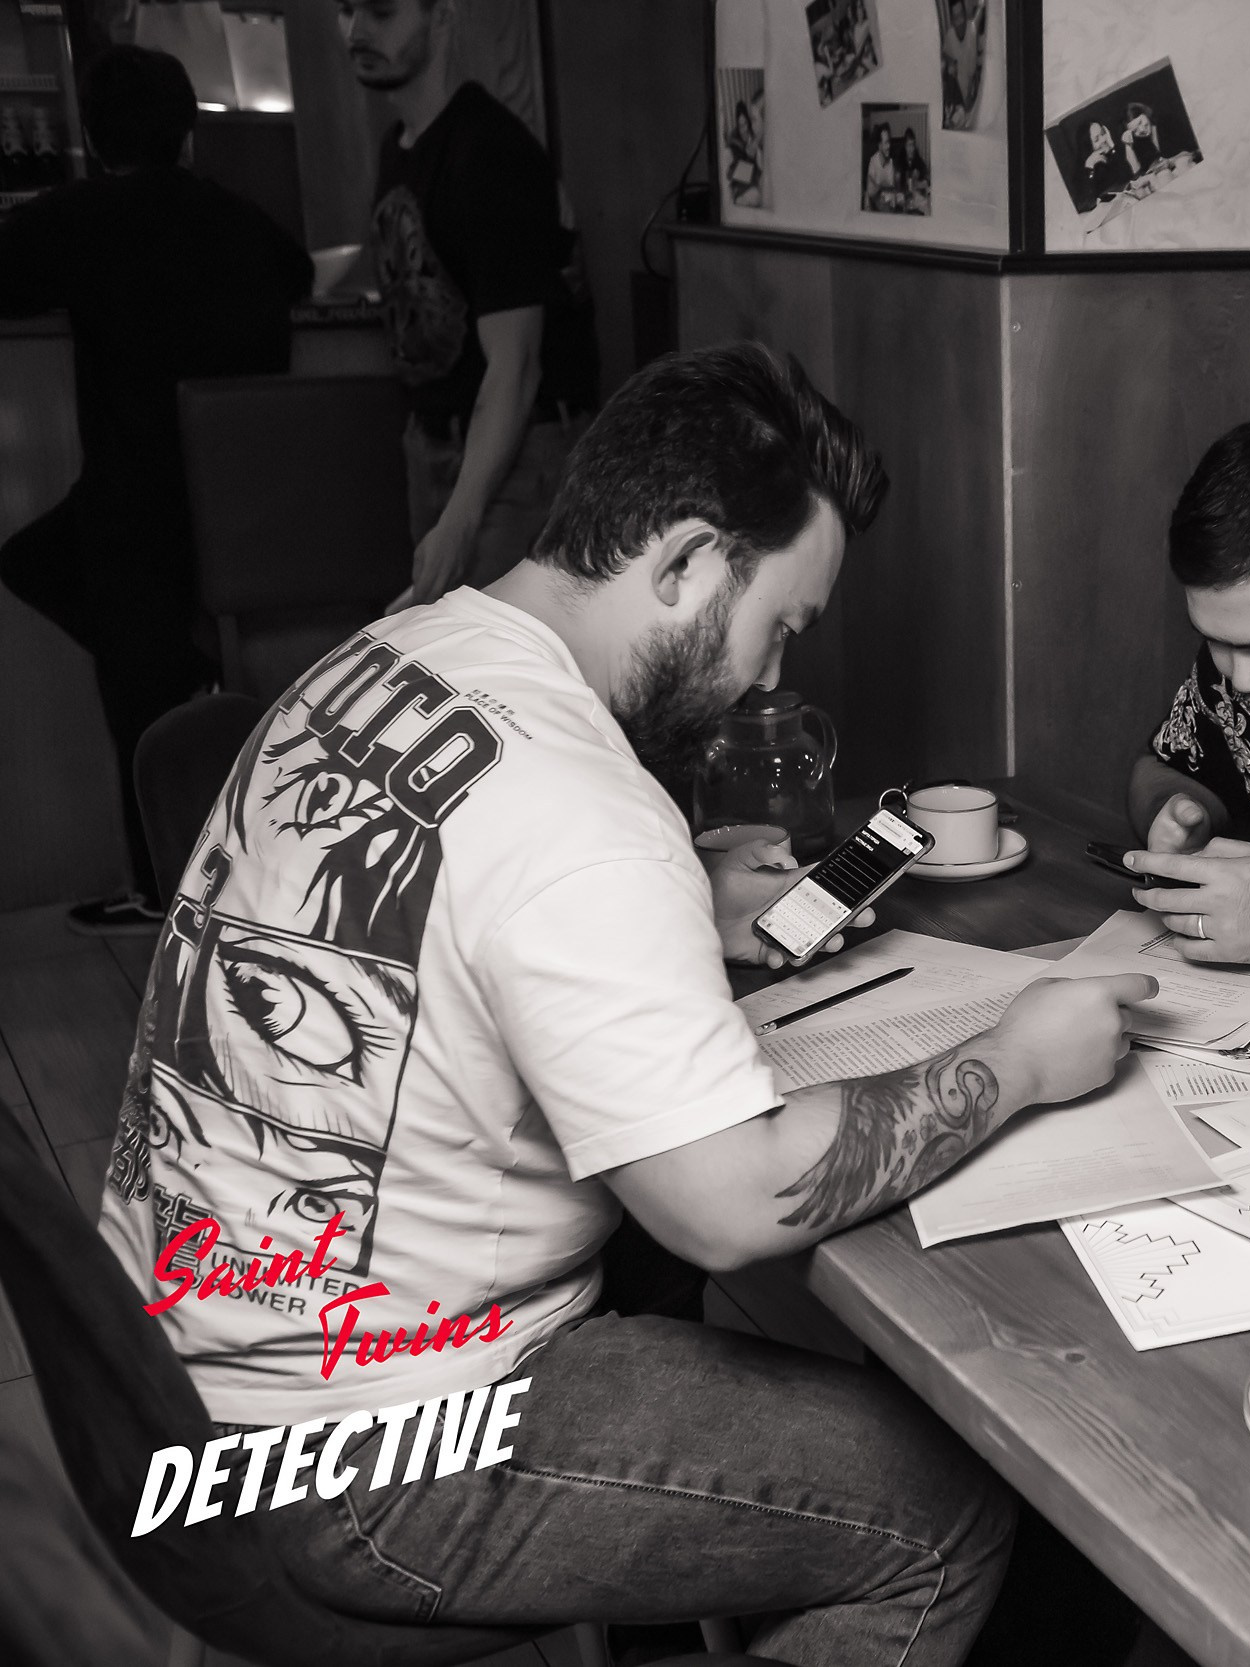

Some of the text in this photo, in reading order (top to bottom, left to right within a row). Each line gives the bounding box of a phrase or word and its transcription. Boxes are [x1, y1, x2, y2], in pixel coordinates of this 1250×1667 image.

[464, 693, 490, 709] PLACE
[488, 706, 502, 716] OF
[500, 714, 533, 740] WISDOM
